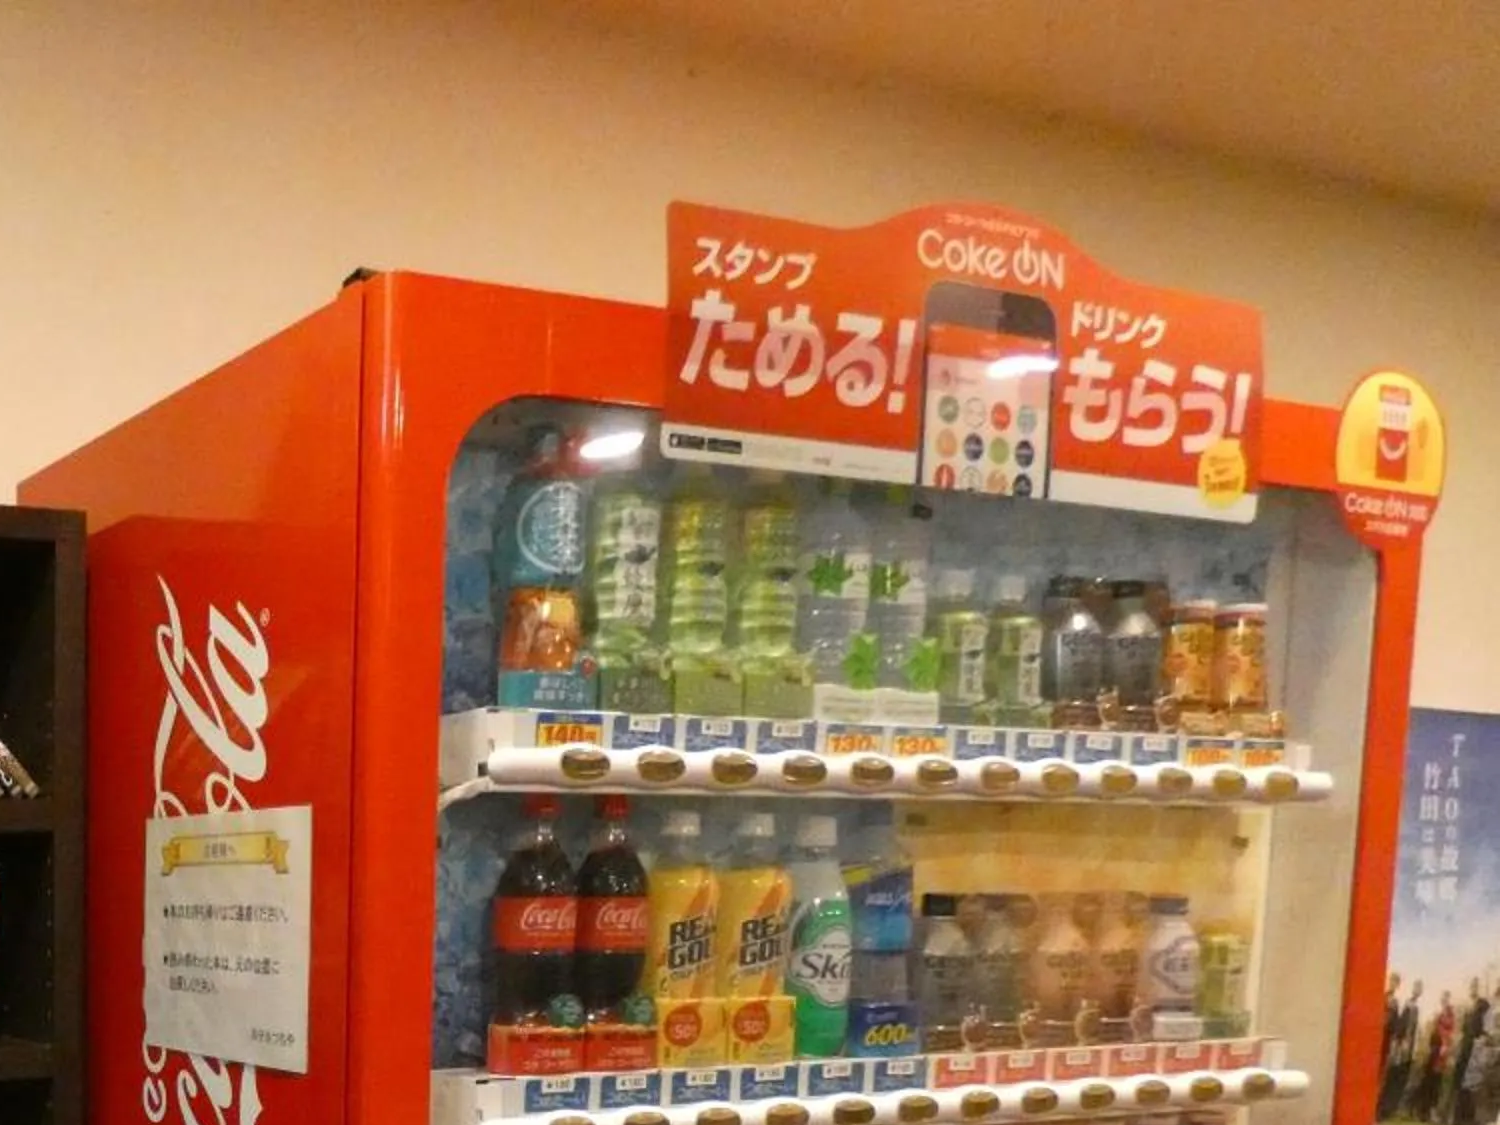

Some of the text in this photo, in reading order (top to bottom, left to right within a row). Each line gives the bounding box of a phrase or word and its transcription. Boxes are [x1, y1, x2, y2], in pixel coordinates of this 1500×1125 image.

[691, 236, 816, 290] スタンプ
[917, 228, 1066, 291] Coke ON
[680, 290, 917, 414] ためる!
[1071, 300, 1167, 348] ドリンク
[1063, 347, 1252, 453] もらう!
